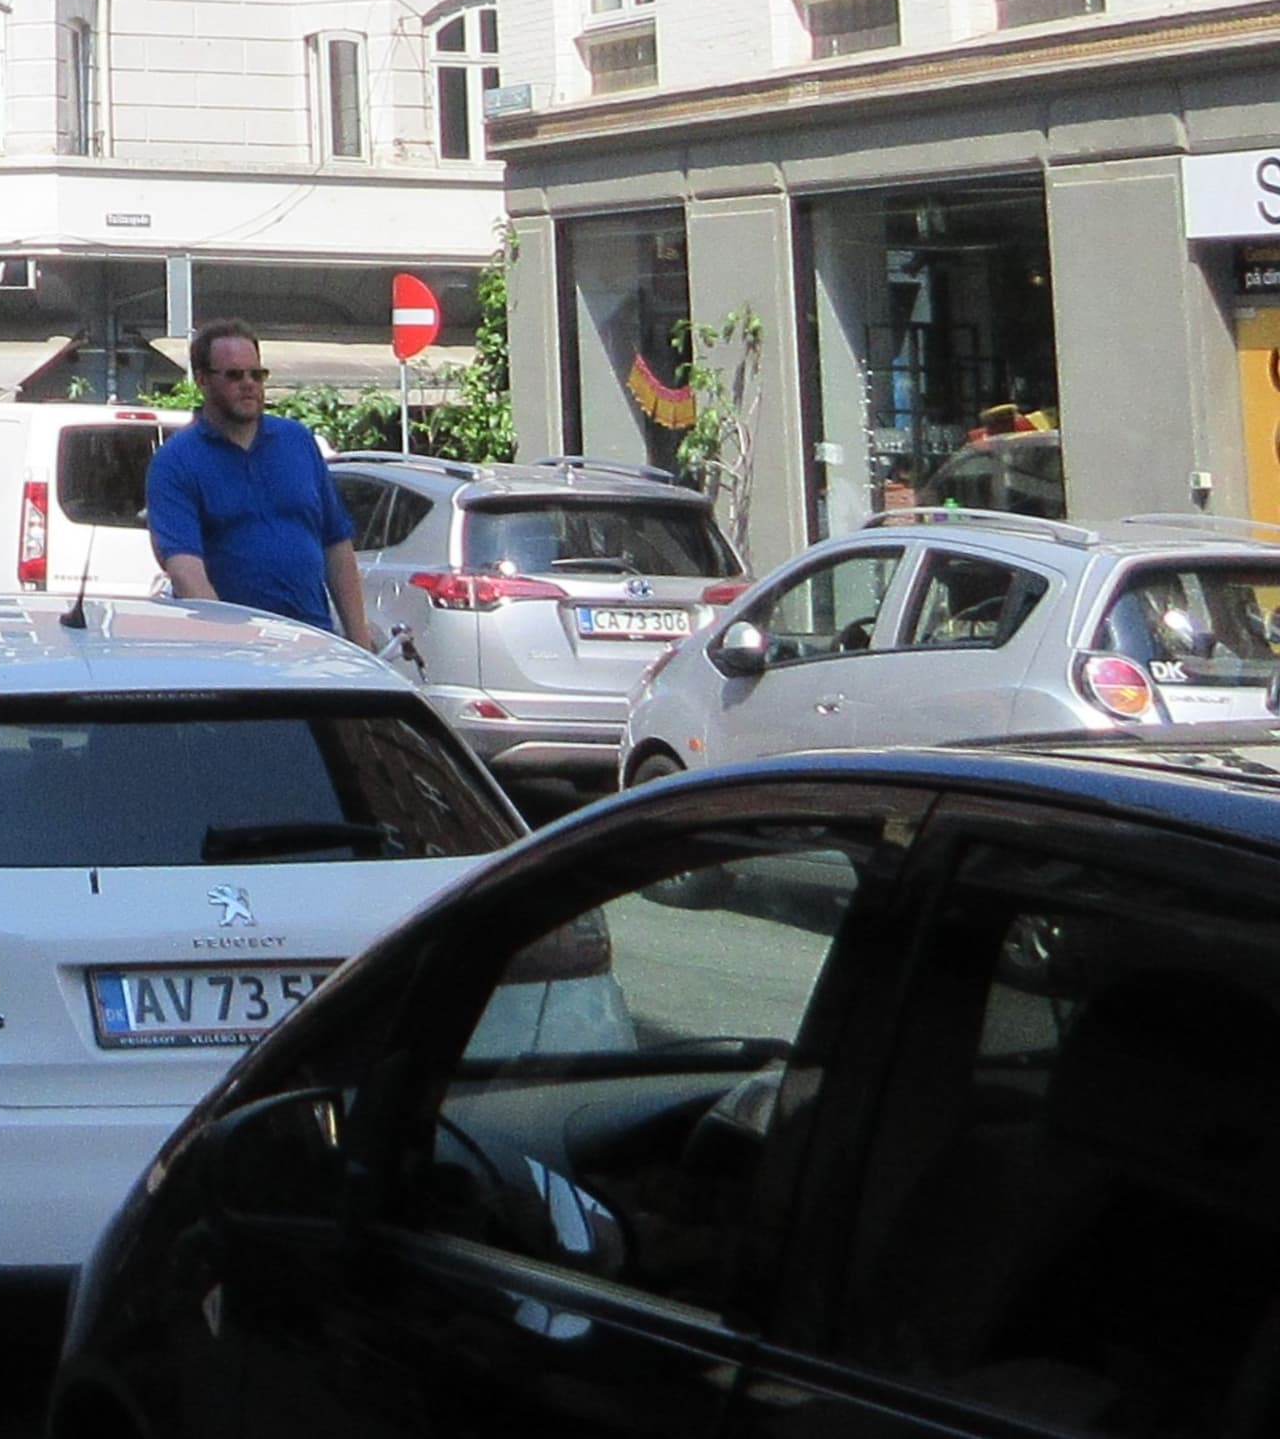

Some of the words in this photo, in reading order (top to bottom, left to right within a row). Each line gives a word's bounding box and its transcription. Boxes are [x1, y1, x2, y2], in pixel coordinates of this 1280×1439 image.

[594, 610, 620, 629] CA
[623, 611, 647, 630] 73
[651, 612, 687, 631] 306
[1149, 661, 1189, 682] DK
[192, 936, 287, 949] PEUGEOT
[135, 976, 193, 1023] AV
[207, 976, 269, 1021] 73
